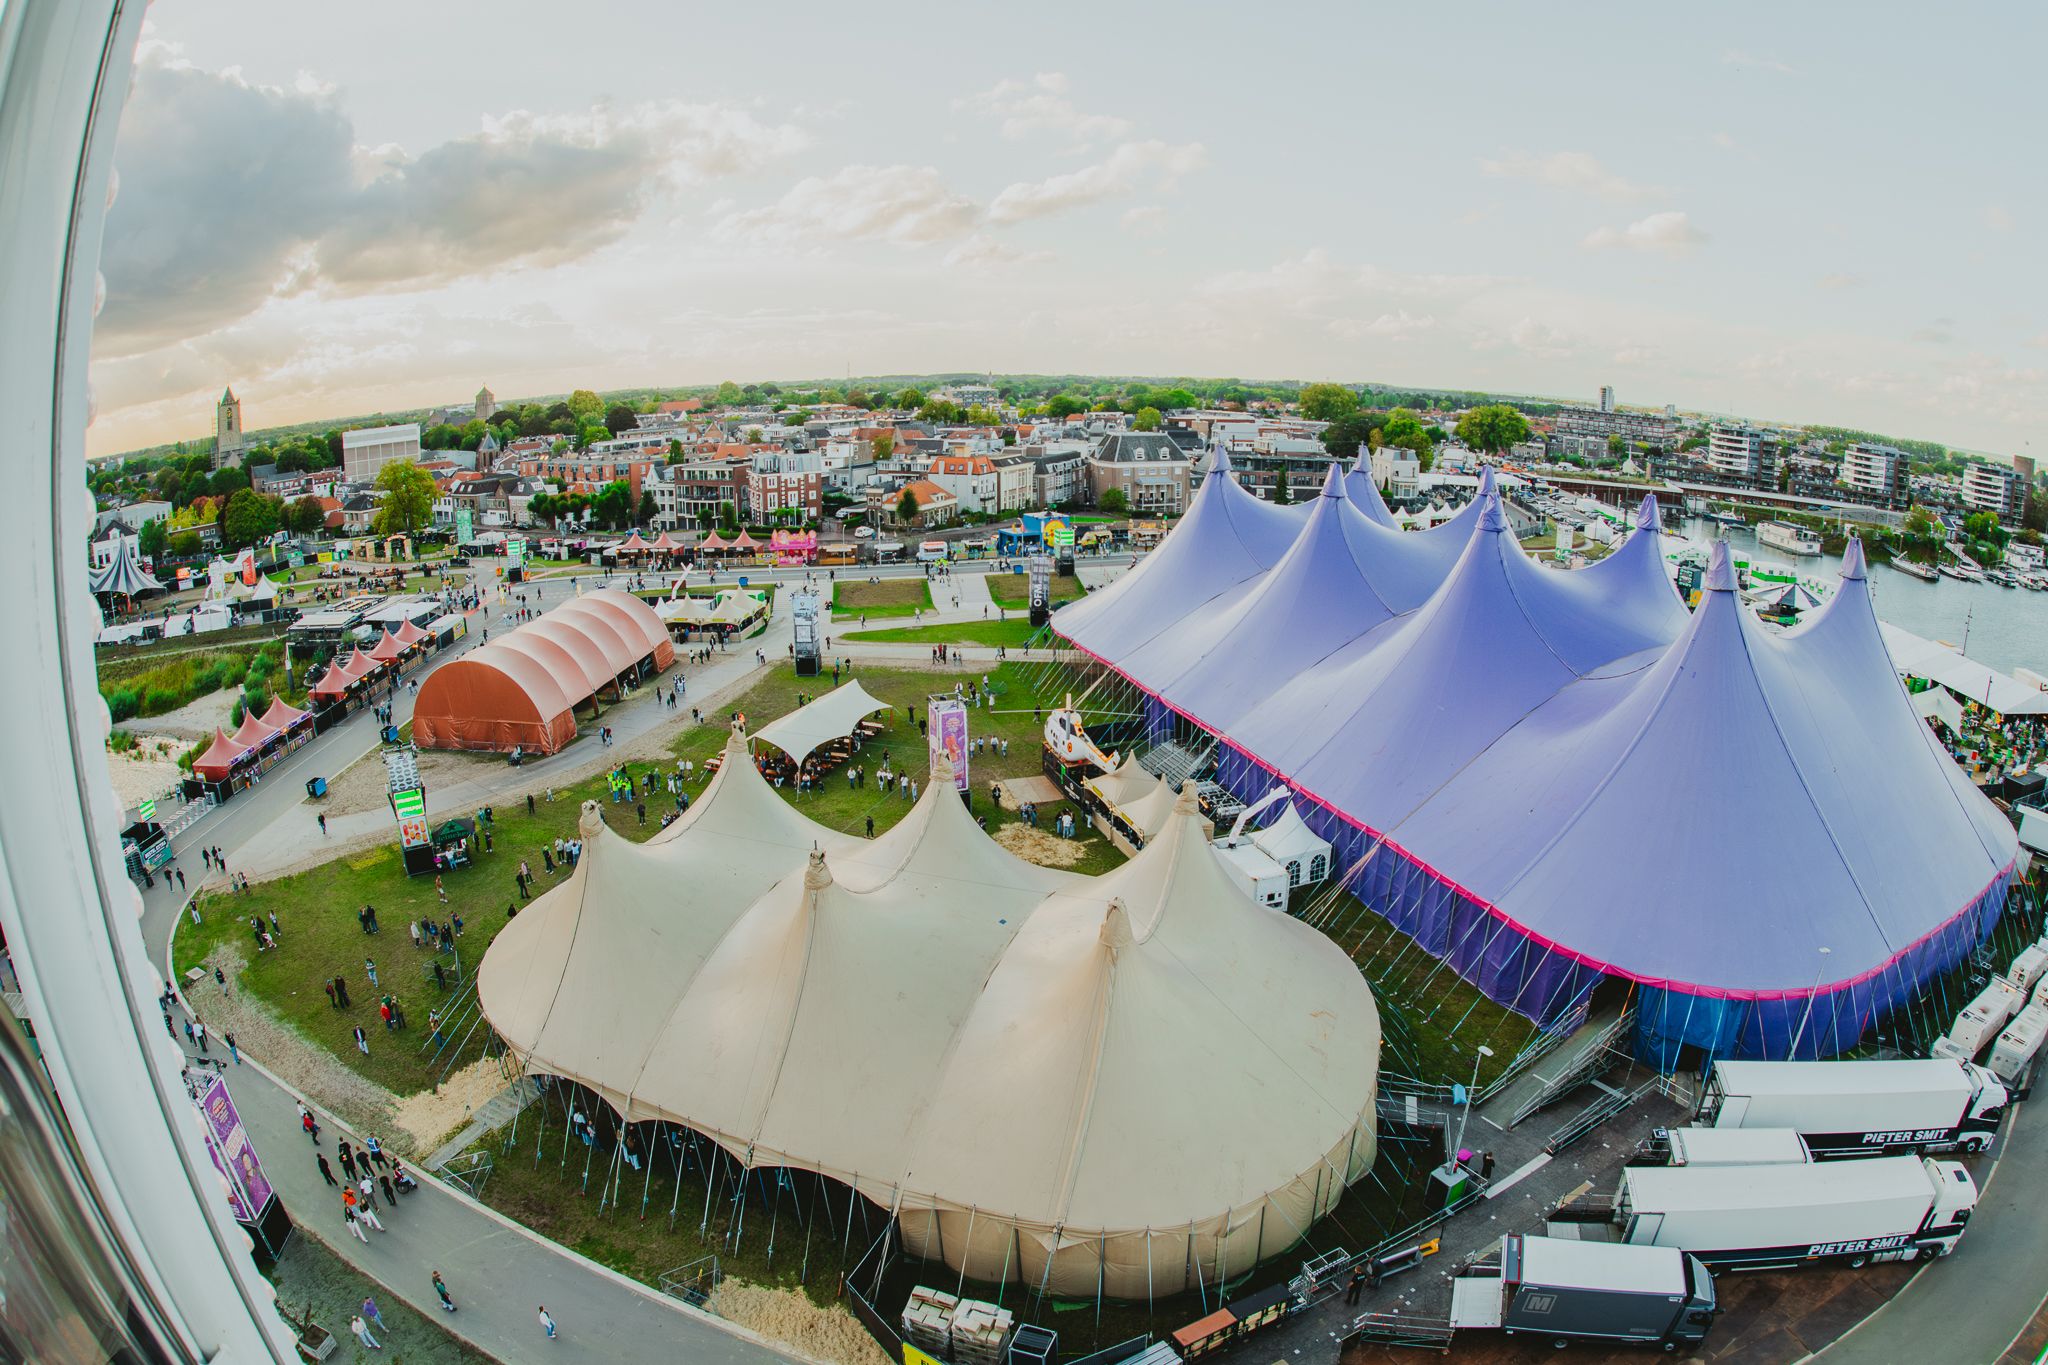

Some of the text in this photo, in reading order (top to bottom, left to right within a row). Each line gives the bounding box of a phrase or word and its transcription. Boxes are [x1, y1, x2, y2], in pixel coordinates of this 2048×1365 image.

[1862, 1128, 1948, 1143] PIETER SMIT
[1808, 1236, 1909, 1255] PIETER SMIT
[1527, 1296, 1552, 1312] M
